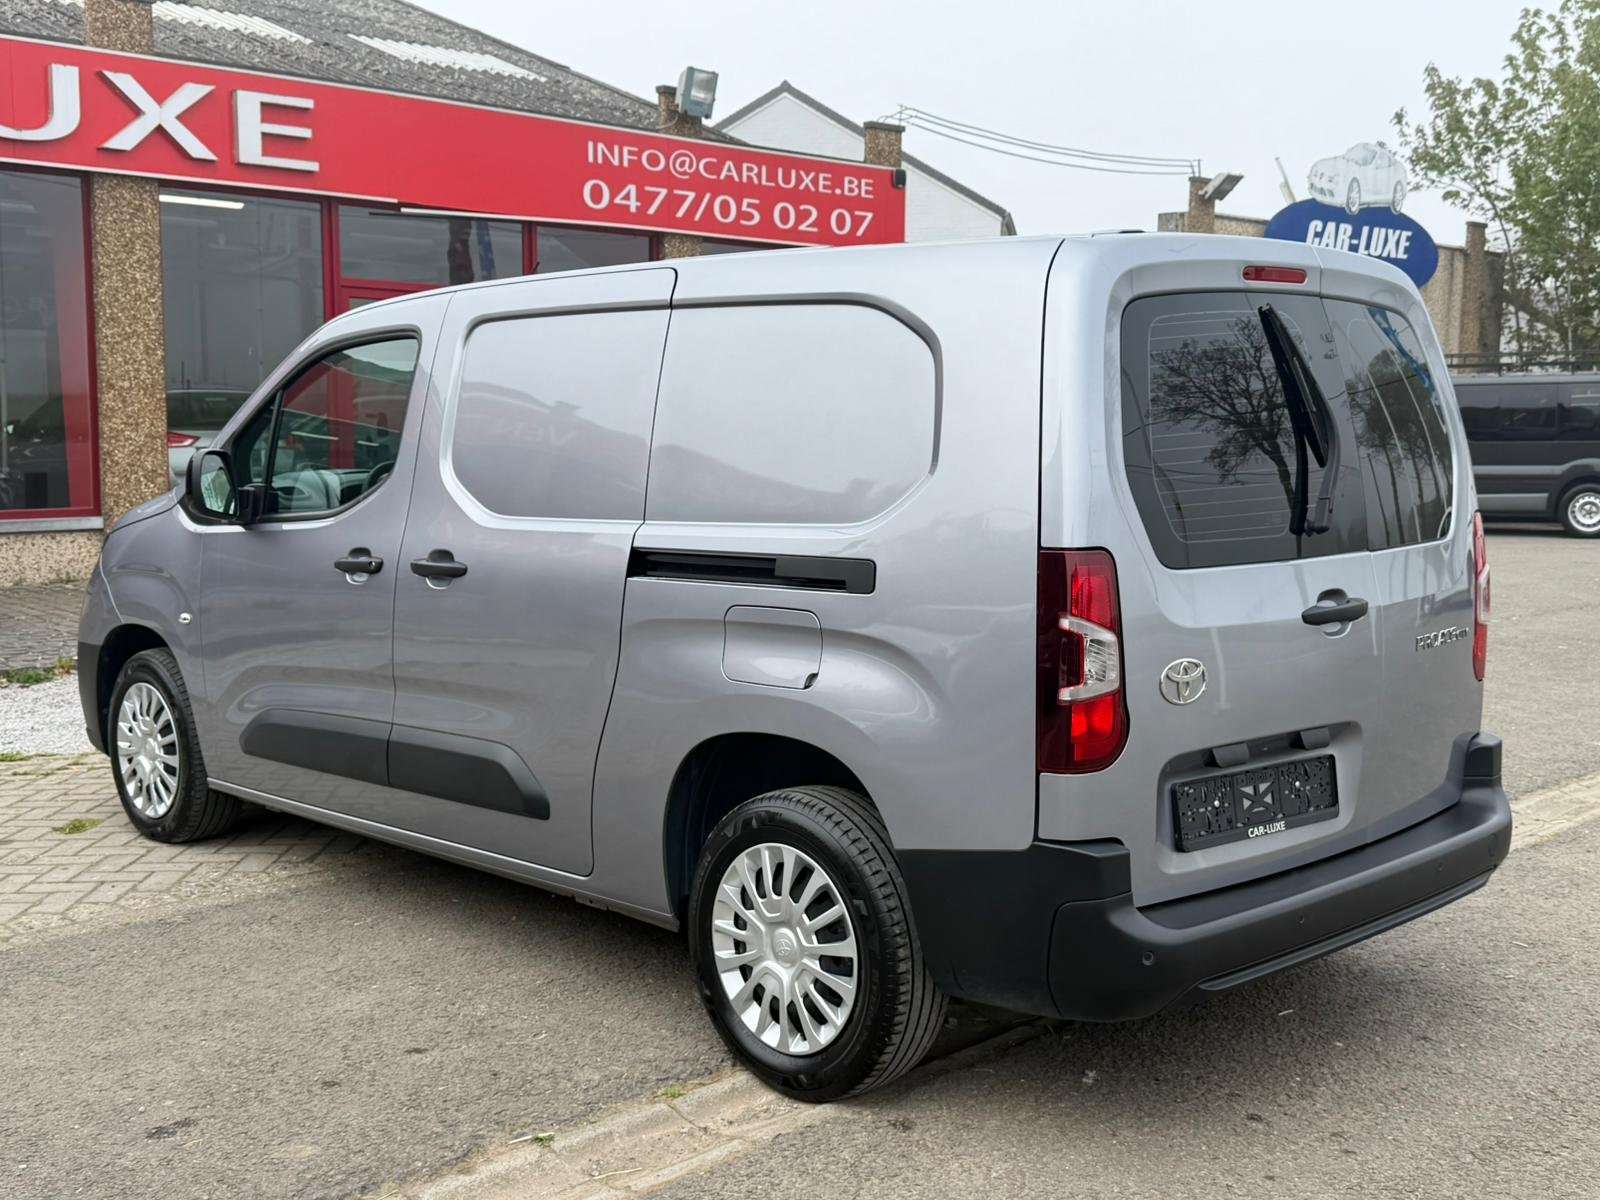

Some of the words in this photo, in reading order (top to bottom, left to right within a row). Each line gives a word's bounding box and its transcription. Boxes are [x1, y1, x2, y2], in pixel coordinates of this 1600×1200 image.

[587, 140, 875, 199] INFO@CARLUXE.BE
[582, 179, 761, 226] 0477/05
[773, 202, 818, 232] 02
[830, 208, 874, 237] 07
[1306, 219, 1413, 260] CAR-LUXE
[1248, 820, 1286, 838] CAR-LUXE
